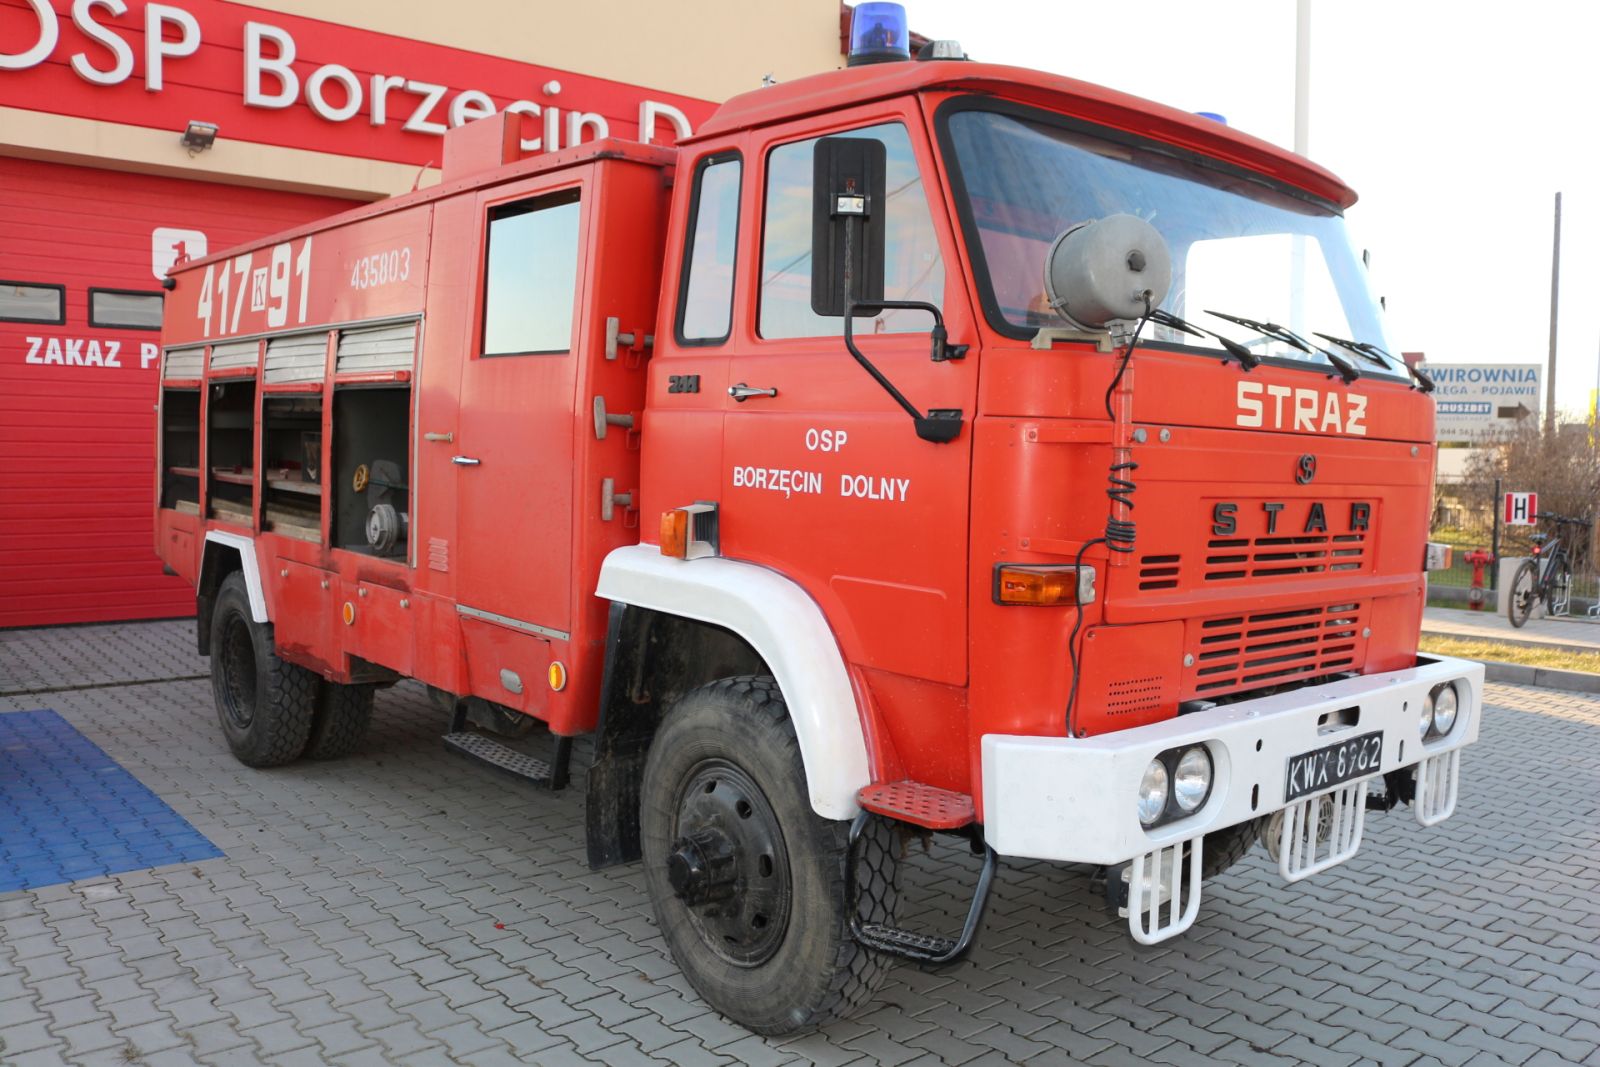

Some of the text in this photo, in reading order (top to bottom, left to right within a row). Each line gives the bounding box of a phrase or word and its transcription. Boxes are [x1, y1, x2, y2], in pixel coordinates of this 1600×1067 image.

[350, 247, 411, 291] 435803
[25, 336, 160, 369] ZAKAZ P
[1481, 385, 1537, 396] POJAWIE
[805, 428, 848, 452] OSP
[733, 466, 910, 501] BORZĘCIN DOLNY
[1212, 503, 1371, 536] STAR
[1514, 498, 1526, 520] H
[1289, 750, 1331, 796] KWX
